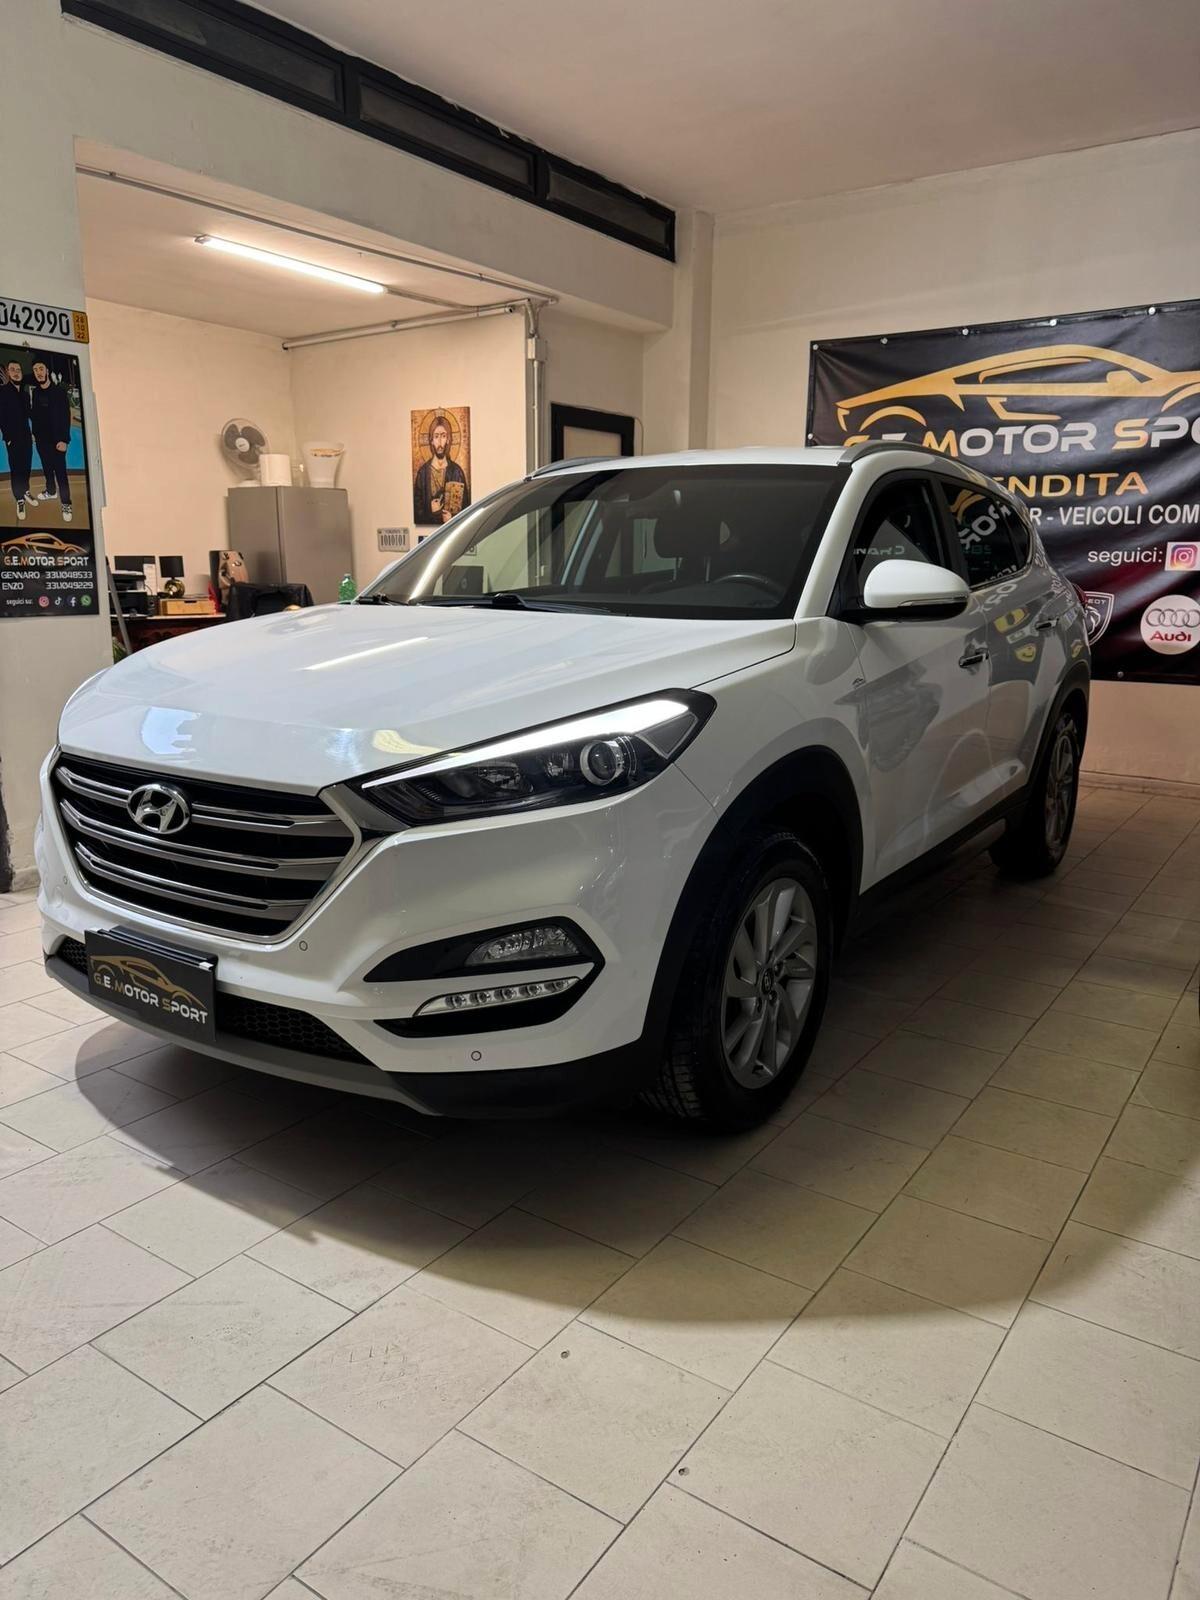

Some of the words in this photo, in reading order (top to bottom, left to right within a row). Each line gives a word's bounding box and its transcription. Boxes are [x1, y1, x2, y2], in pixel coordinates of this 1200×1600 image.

[1112, 416, 1200, 449] SP
[994, 471, 1149, 498] NDITA
[1059, 505, 1142, 525] VEICOLI
[1148, 504, 1200, 524] COM
[57, 556, 89, 566] SPORT
[1087, 547, 1163, 567] seguici:
[1, 571, 40, 579] GENNARO
[2, 582, 24, 590] ENZO
[1150, 630, 1192, 642] Audi
[161, 997, 208, 1024] SPORT
